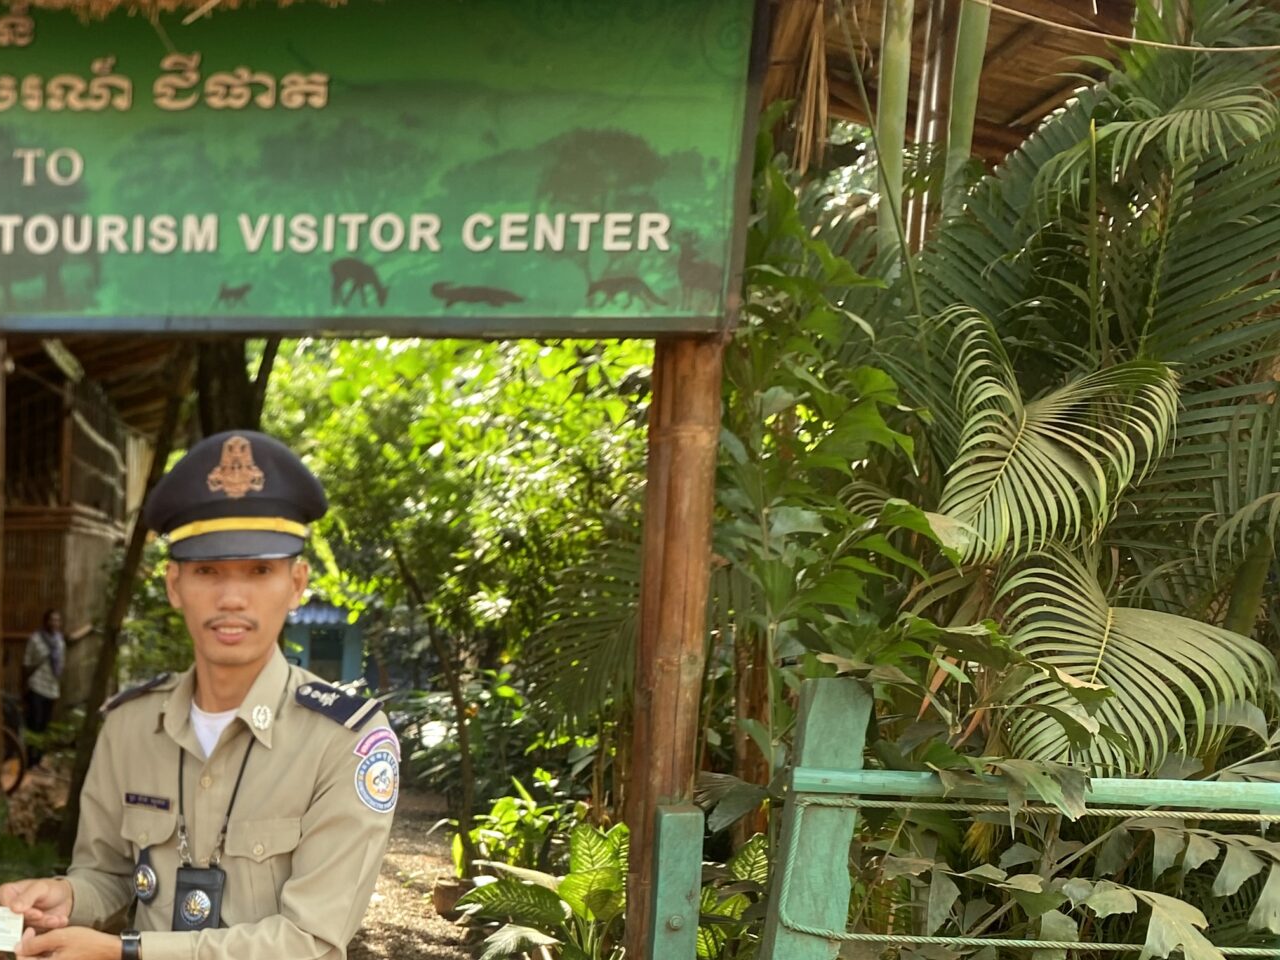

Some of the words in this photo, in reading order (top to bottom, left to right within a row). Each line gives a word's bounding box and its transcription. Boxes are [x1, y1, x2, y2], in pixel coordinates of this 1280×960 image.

[12, 147, 84, 187] TO
[237, 213, 441, 253] VISITOR
[461, 213, 673, 253] CENTER
